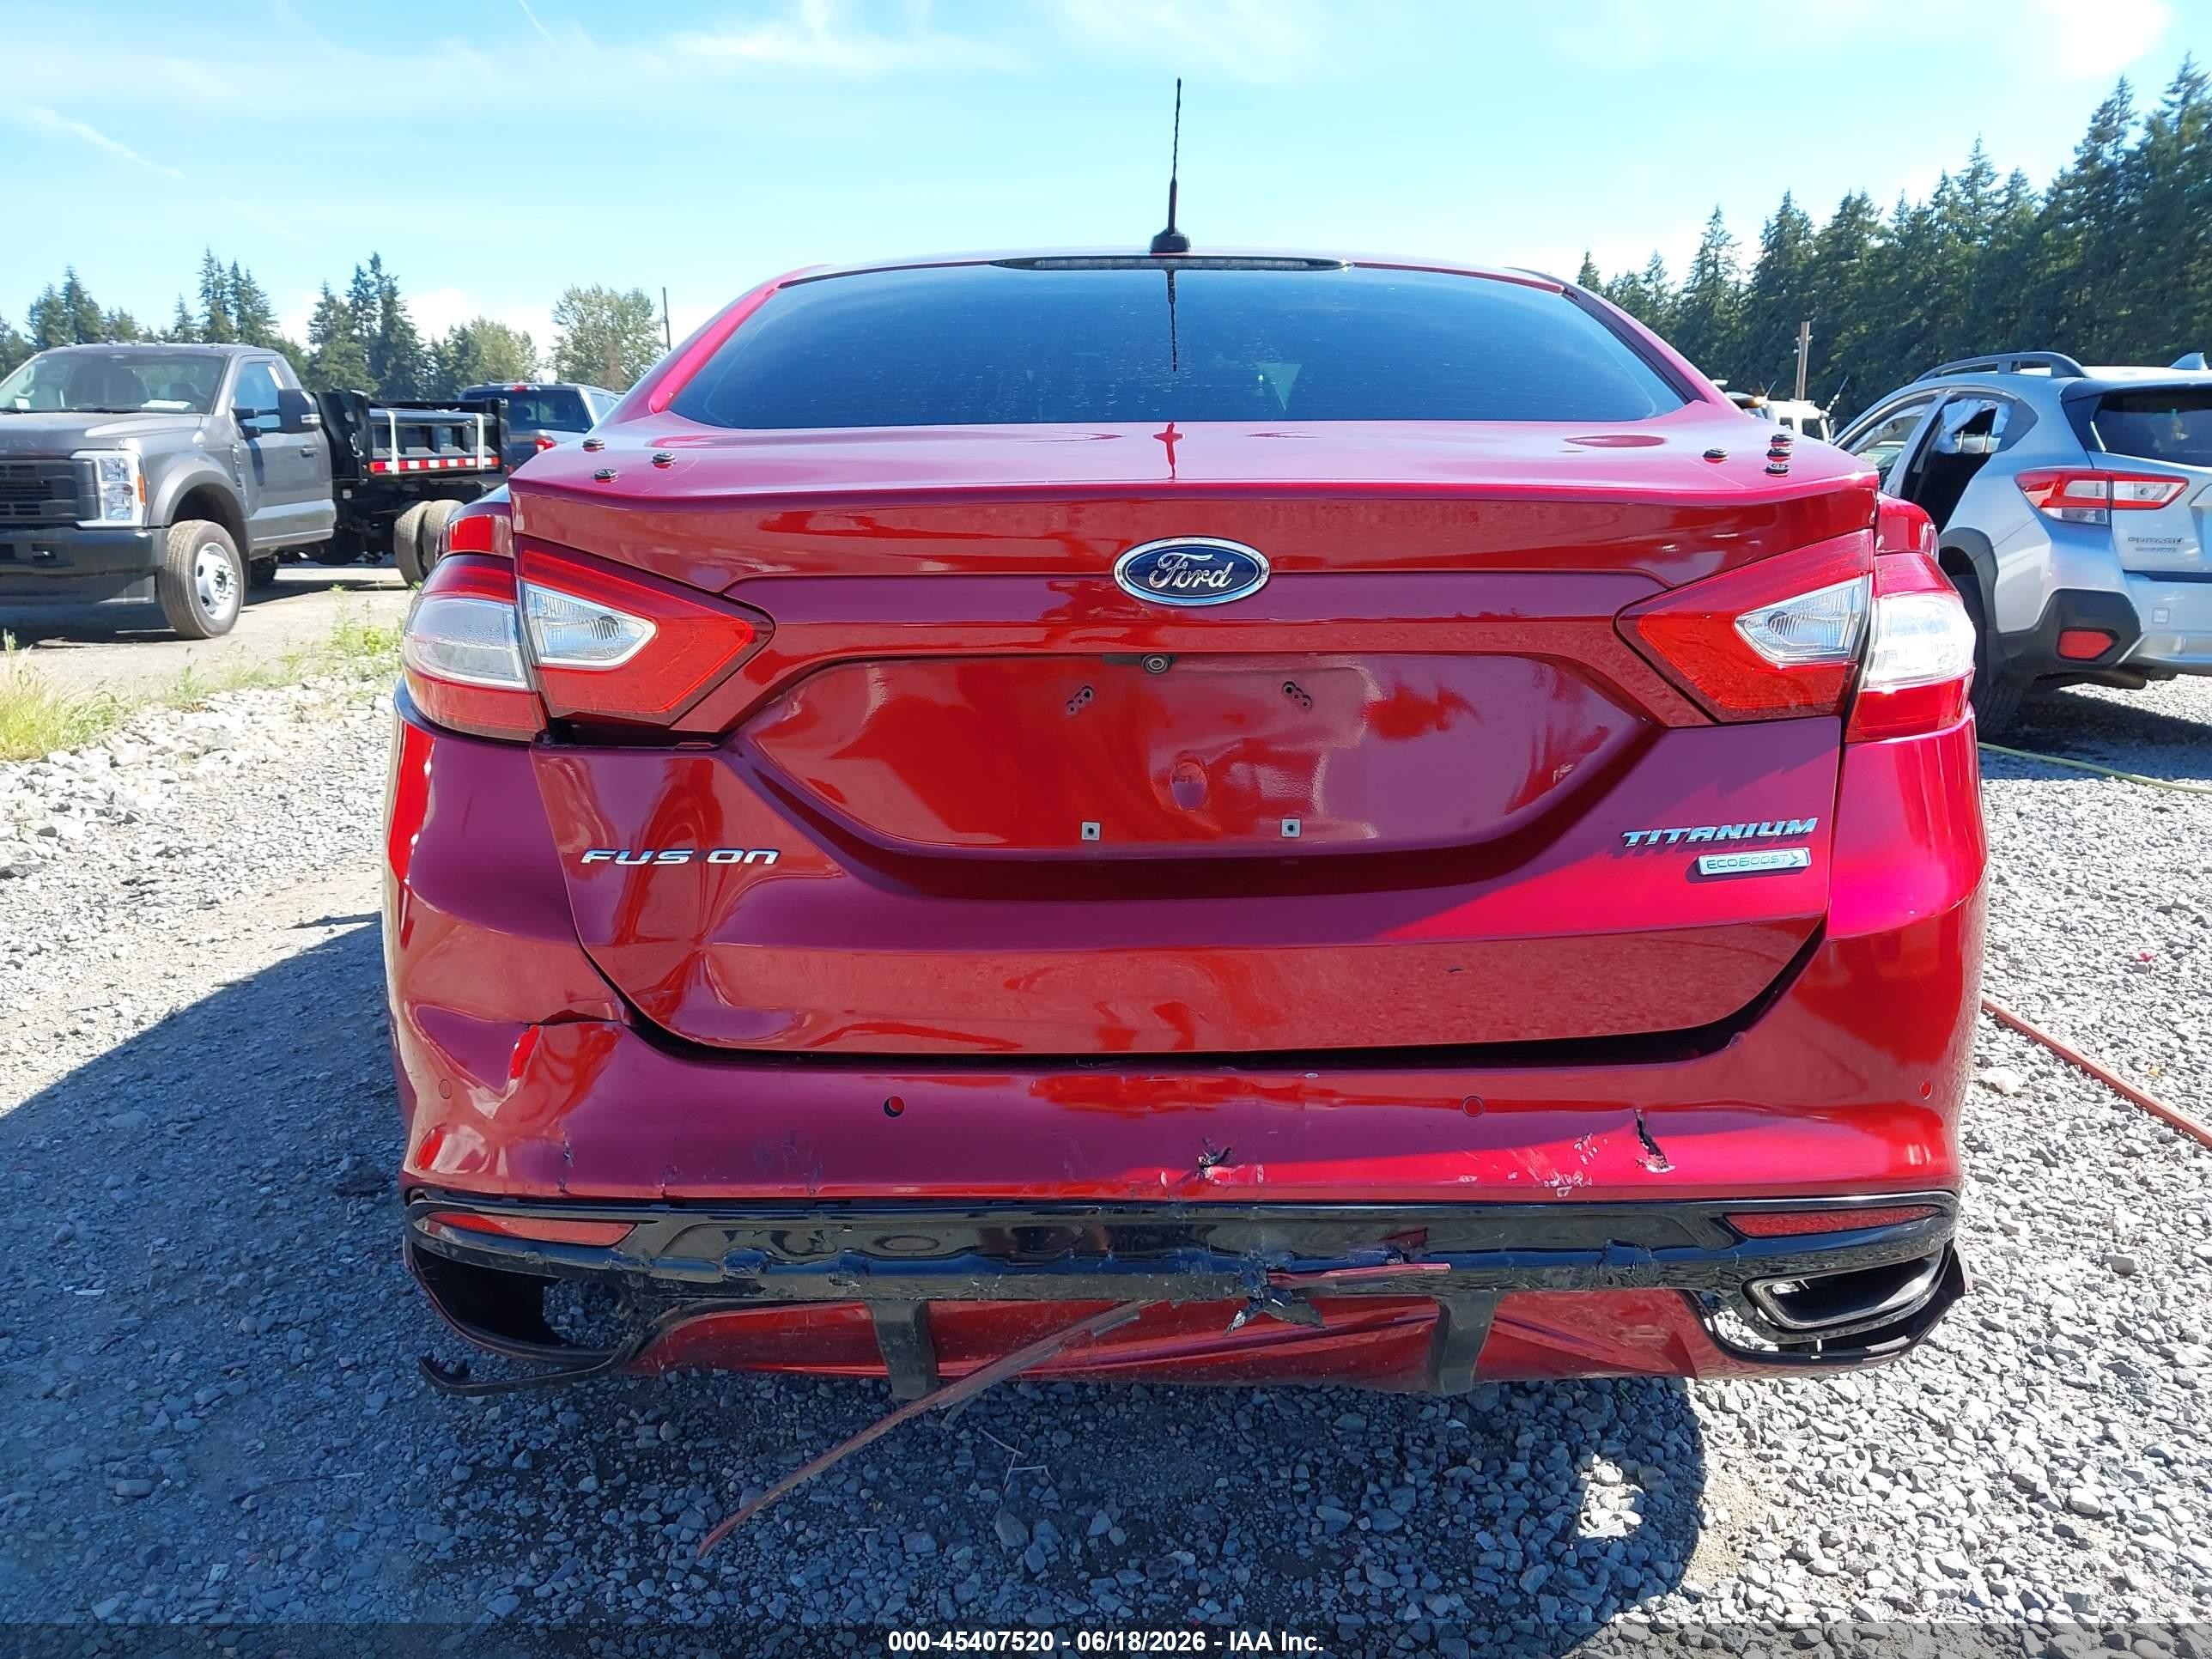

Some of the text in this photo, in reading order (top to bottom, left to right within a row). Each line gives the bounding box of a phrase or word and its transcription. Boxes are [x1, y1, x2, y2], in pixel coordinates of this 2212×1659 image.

[1148, 551, 1235, 589] Ford
[1621, 817, 1820, 848] TITANIUM
[1705, 853, 1790, 871] ECOBOOST
